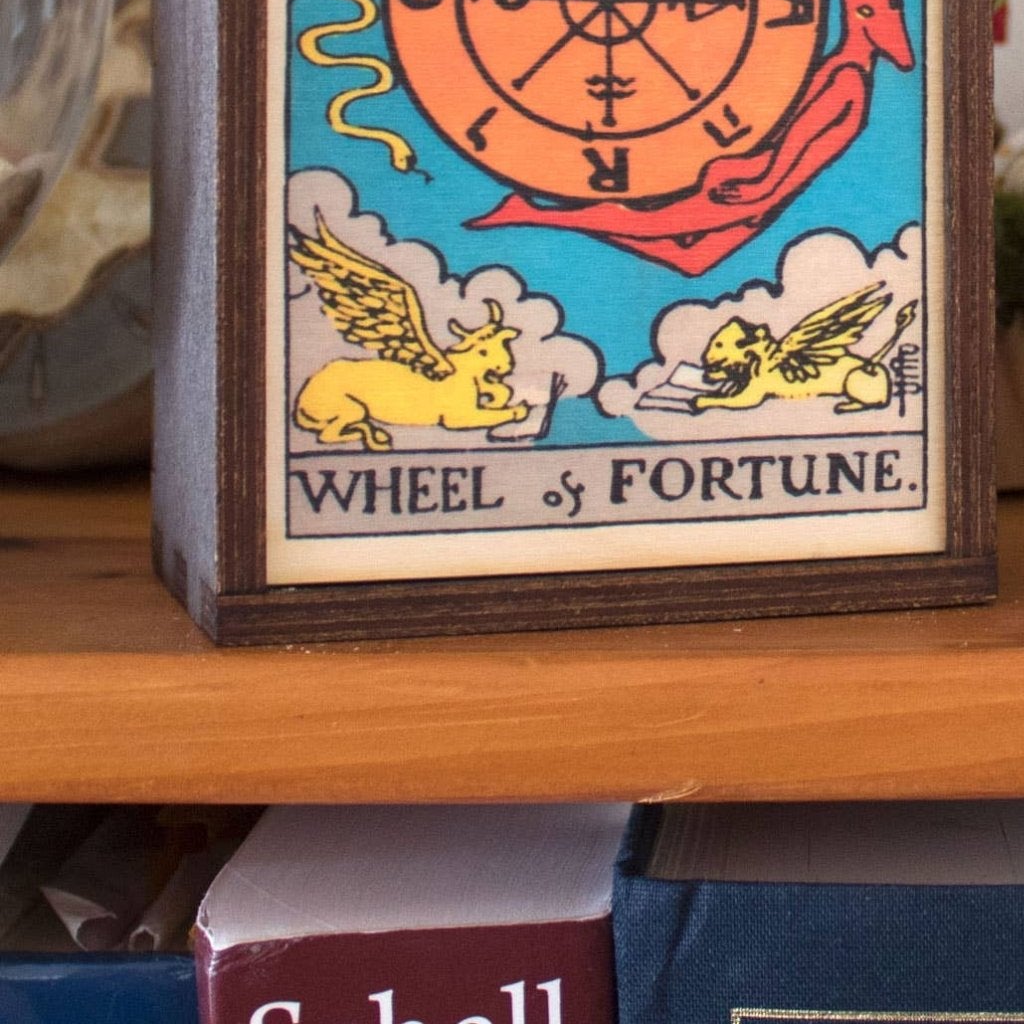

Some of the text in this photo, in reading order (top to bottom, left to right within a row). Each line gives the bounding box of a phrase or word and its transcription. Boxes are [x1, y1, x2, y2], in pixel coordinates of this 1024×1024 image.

[581, 147, 630, 194] R
[289, 449, 918, 517] WHEEL of FORTUNE.
